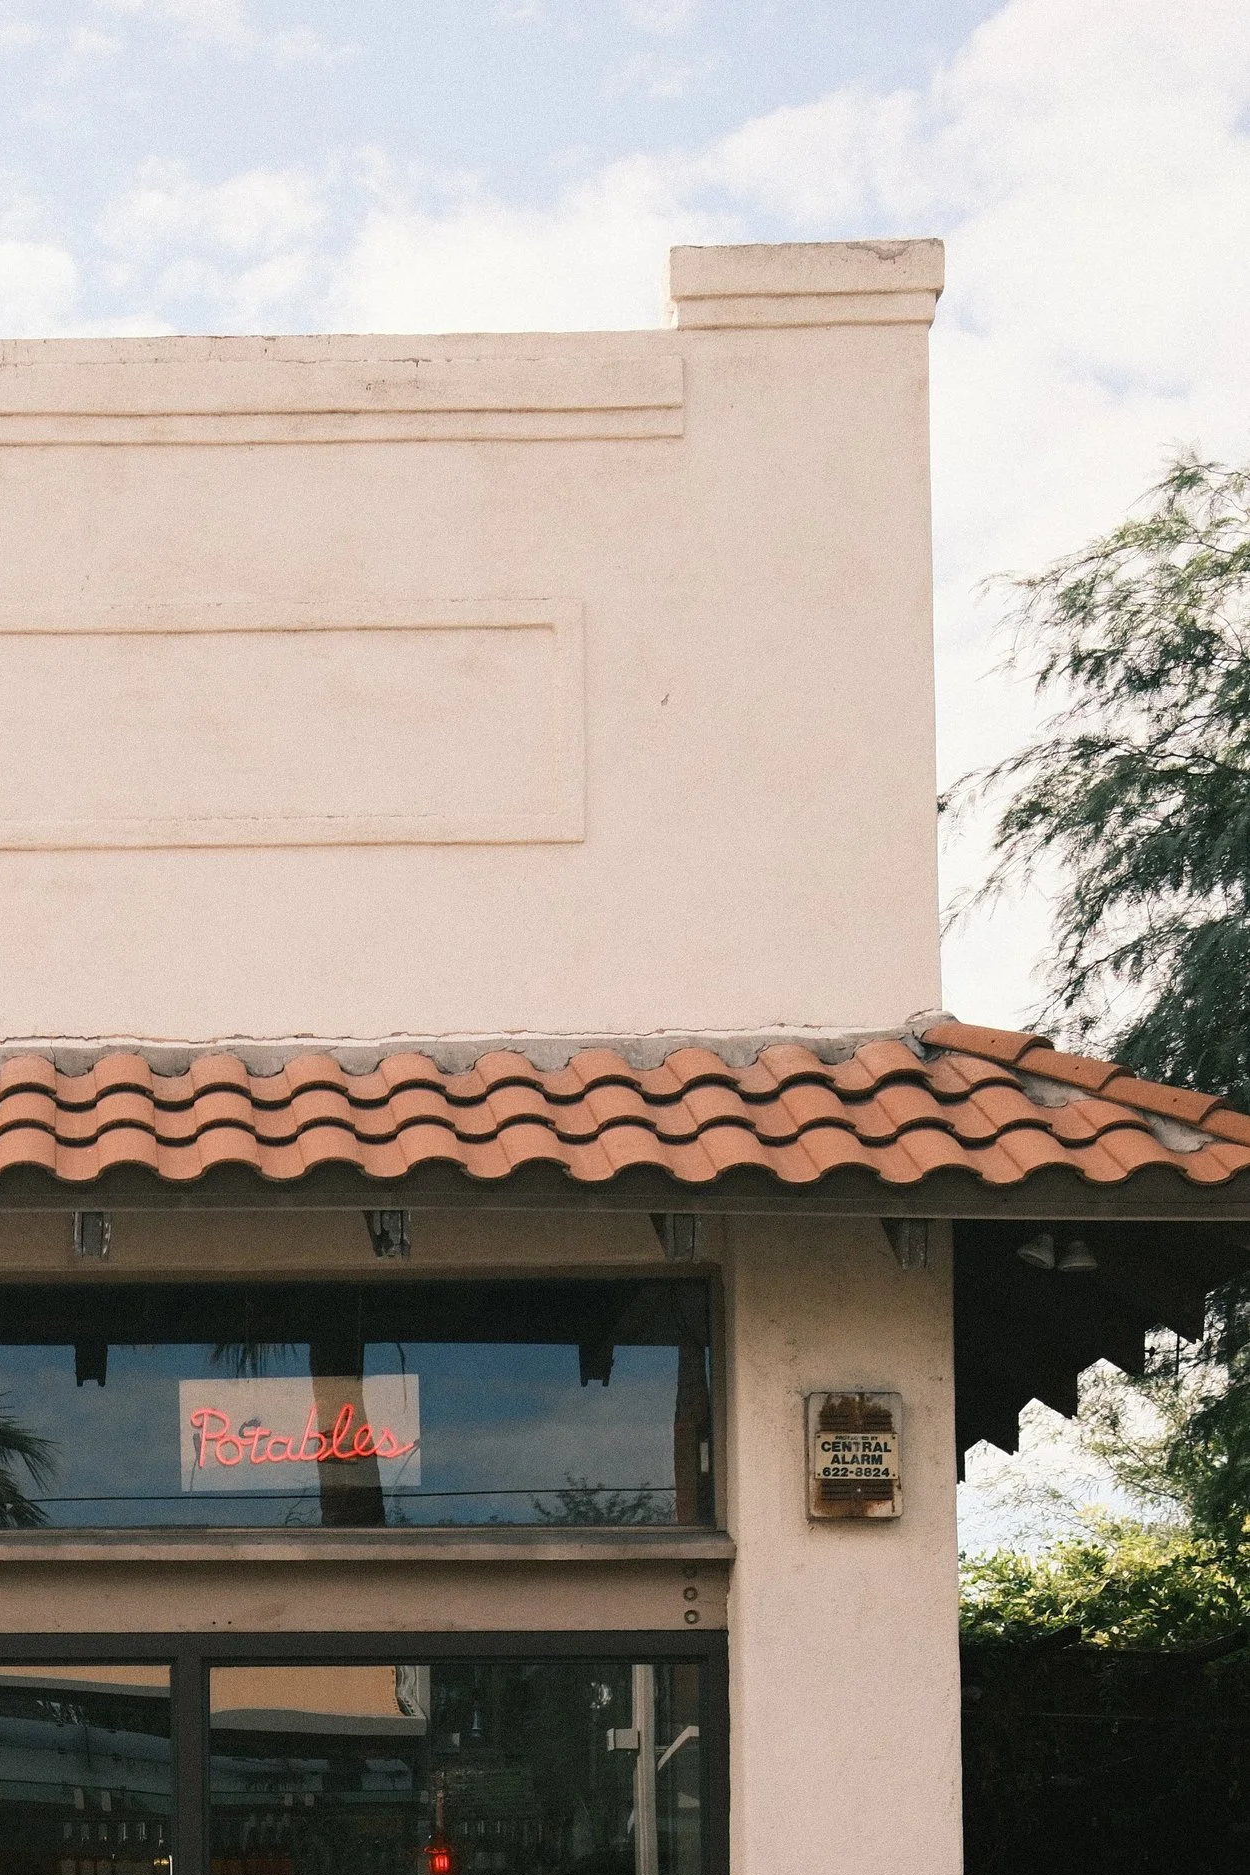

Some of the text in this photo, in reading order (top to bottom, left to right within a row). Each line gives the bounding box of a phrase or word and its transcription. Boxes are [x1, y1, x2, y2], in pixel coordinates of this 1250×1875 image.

[190, 1403, 416, 1468] Potables
[821, 1441, 892, 1453] CENTRAL
[830, 1454, 883, 1466] ALARM
[822, 1467, 890, 1478] 622-8824
